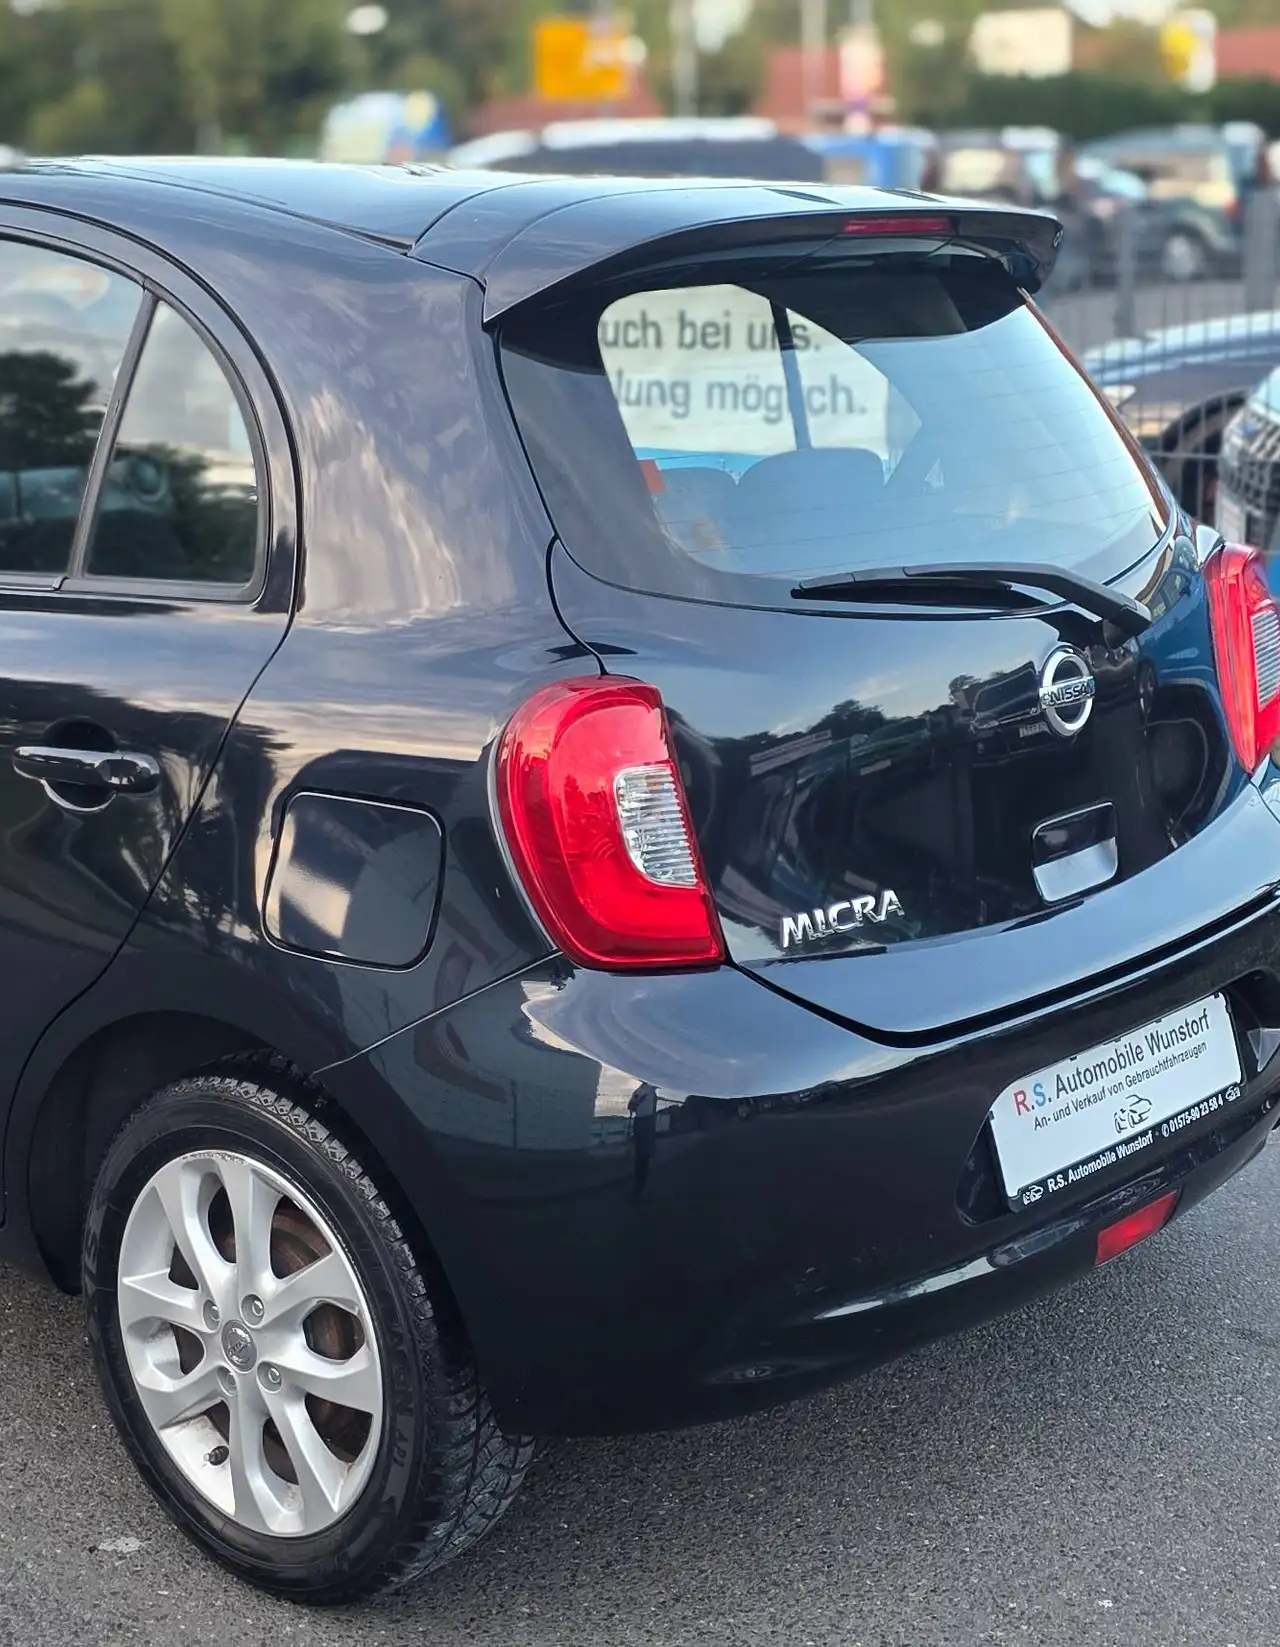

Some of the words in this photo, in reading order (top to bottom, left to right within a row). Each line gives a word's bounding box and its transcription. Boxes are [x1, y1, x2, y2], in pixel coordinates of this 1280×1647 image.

[678, 309, 731, 350] bei
[1050, 679, 1094, 702] NISSAN
[781, 889, 905, 948] MICRA
[1013, 1083, 1052, 1116] R.S.
[1056, 1042, 1145, 1099] Automobile
[1145, 1008, 1210, 1056] Wunstorf
[1034, 1116, 1051, 1131] An-
[1053, 1103, 1071, 1122] und
[1071, 1086, 1107, 1113] Verkauf
[1107, 1081, 1124, 1096] von
[1125, 1042, 1208, 1088] Gebrauchtfahrzeugen
[1047, 1174, 1068, 1192] R.S.
[1068, 1150, 1117, 1183] Automobile
[1116, 1130, 1153, 1159] Wunstorf
